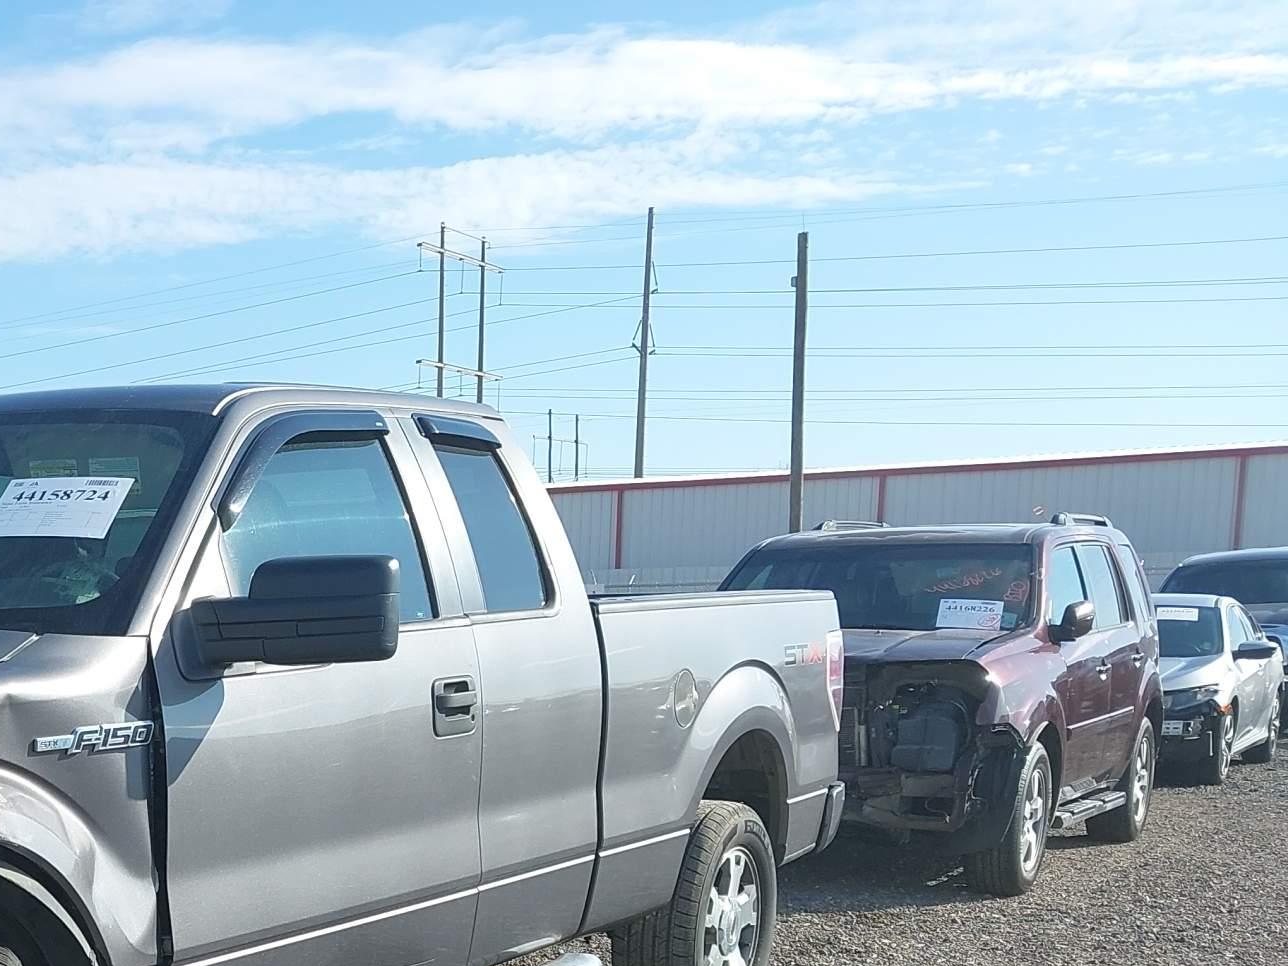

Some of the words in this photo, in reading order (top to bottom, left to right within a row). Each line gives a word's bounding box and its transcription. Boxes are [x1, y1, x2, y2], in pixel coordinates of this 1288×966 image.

[13, 489, 112, 502] 44158724
[39, 738, 59, 749] STX
[71, 721, 154, 752] F-150
